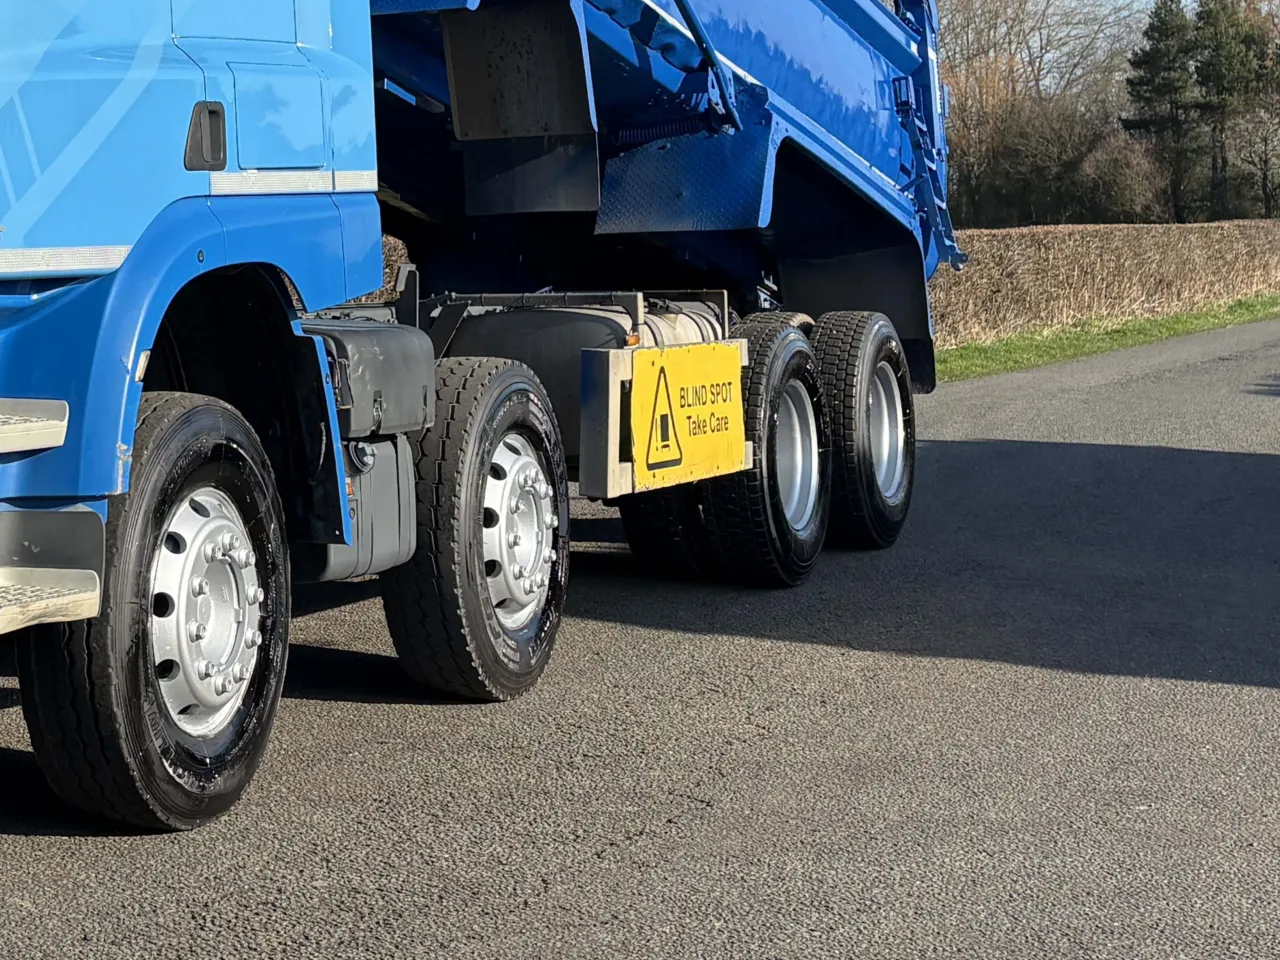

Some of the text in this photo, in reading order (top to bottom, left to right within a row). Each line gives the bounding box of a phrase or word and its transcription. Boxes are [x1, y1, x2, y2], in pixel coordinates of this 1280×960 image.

[680, 381, 733, 409] BLIND SPOT
[686, 412, 729, 437] Take Care
